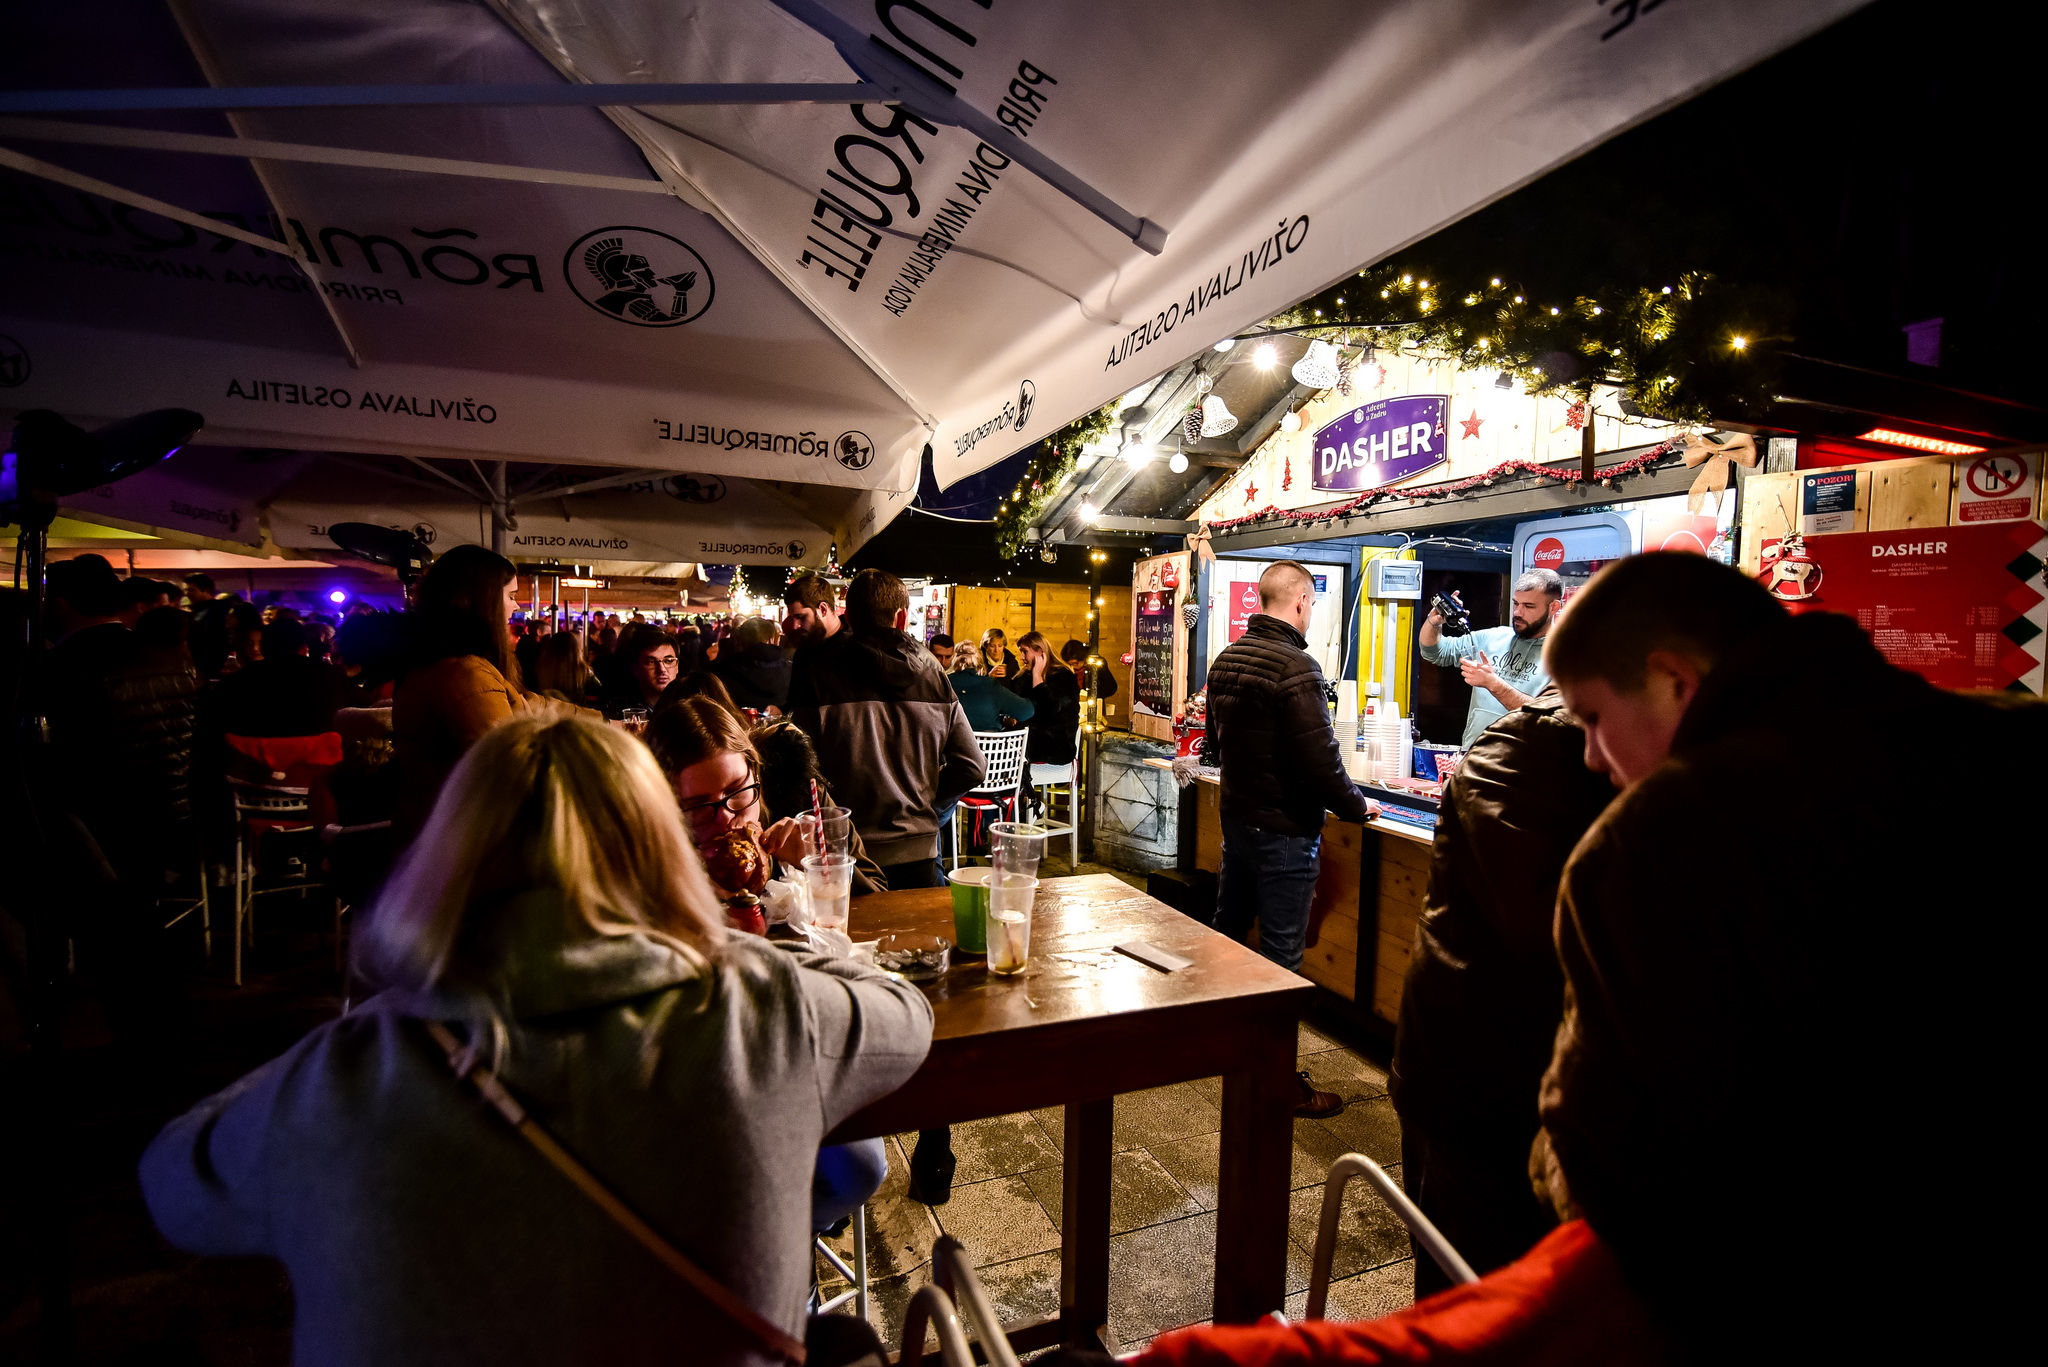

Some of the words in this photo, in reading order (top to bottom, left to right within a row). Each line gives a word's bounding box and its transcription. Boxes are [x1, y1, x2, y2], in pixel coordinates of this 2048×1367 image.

[1365, 401, 1387, 413] Advent
[1321, 421, 1433, 477] DASHER
[1817, 474, 1854, 485] POZOR!
[1871, 541, 1948, 558] DASHER
